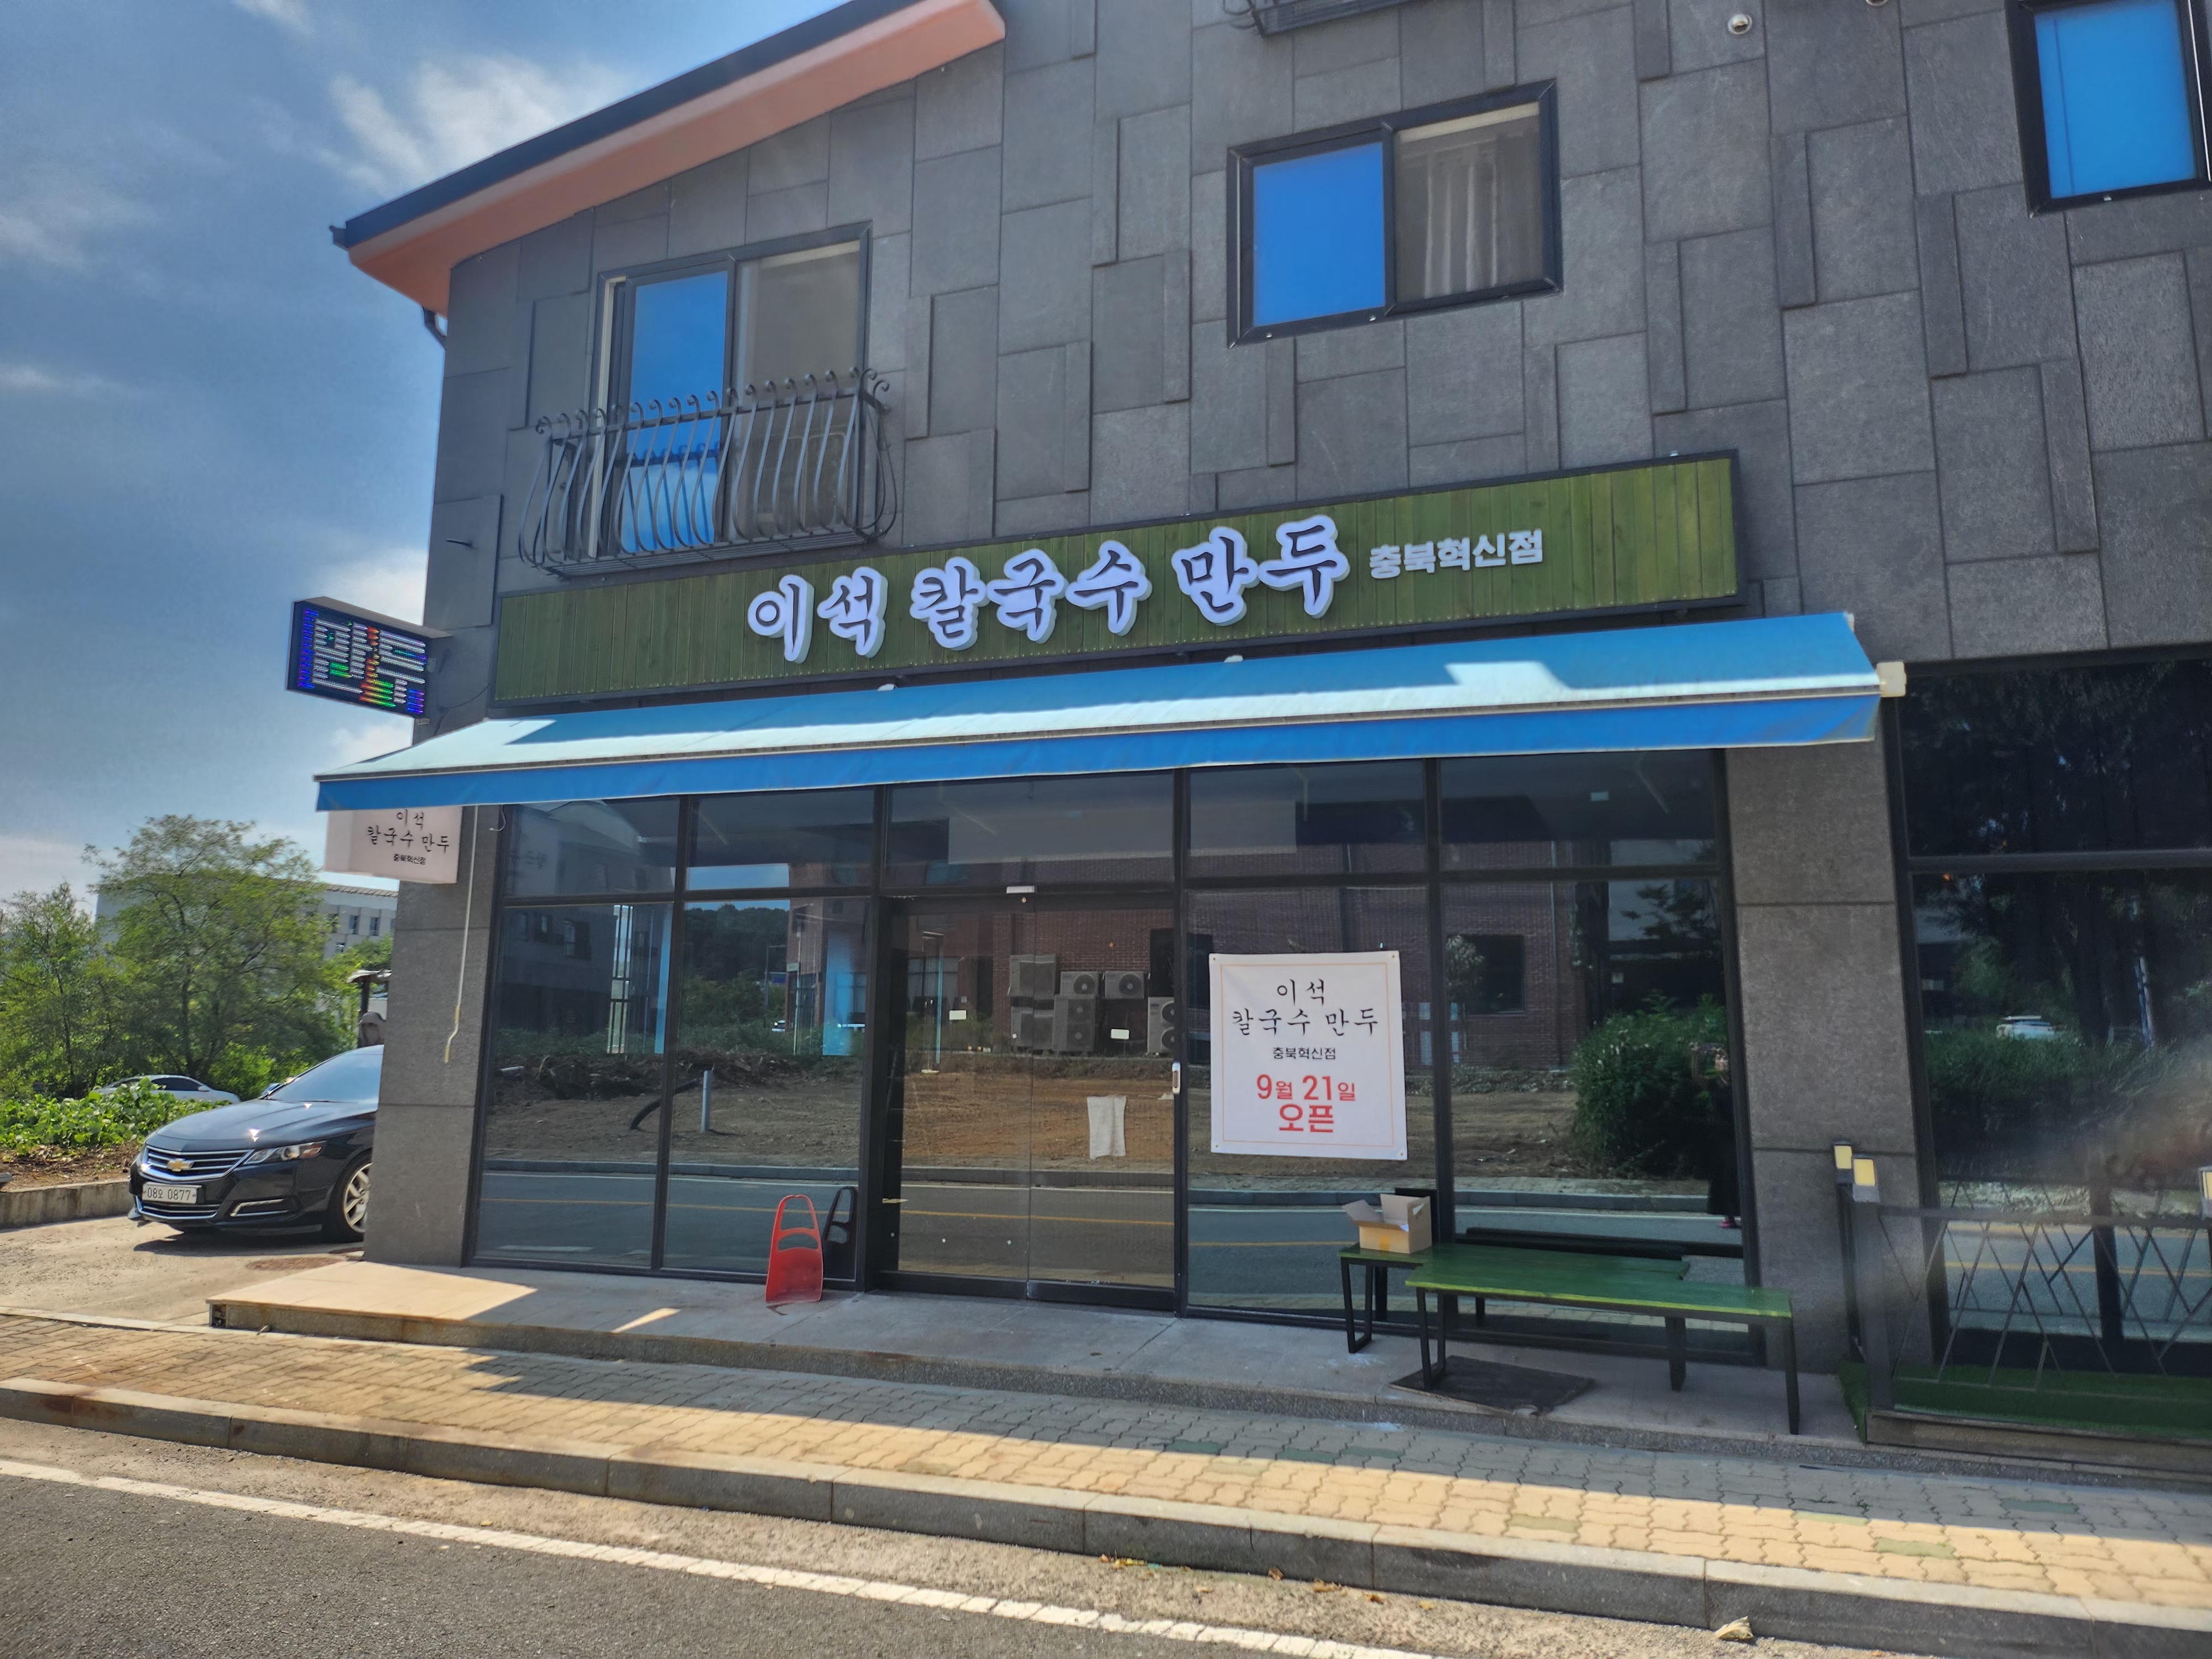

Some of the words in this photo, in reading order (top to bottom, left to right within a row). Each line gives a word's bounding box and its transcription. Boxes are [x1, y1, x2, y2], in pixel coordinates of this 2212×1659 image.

[748, 567, 887, 662] 이석
[910, 540, 1152, 650] 칼국수
[1171, 515, 1350, 626] 만두
[1369, 528, 1543, 579] 충북혁신점
[397, 809, 425, 829] 이석
[367, 825, 414, 849] 칼국수
[421, 833, 450, 854] 만두
[393, 853, 426, 865] 충북혁신점
[1277, 978, 1324, 1006] 이석
[1232, 1008, 1311, 1036] 칼국수
[1326, 1008, 1378, 1036] 만두
[1273, 1047, 1336, 1060] 충북혁신점
[1256, 1073, 1293, 1100] 9월
[1302, 1074, 1356, 1102] 21일
[1279, 1103, 1334, 1133] 오픈
[168, 1188, 191, 1201] 0877
